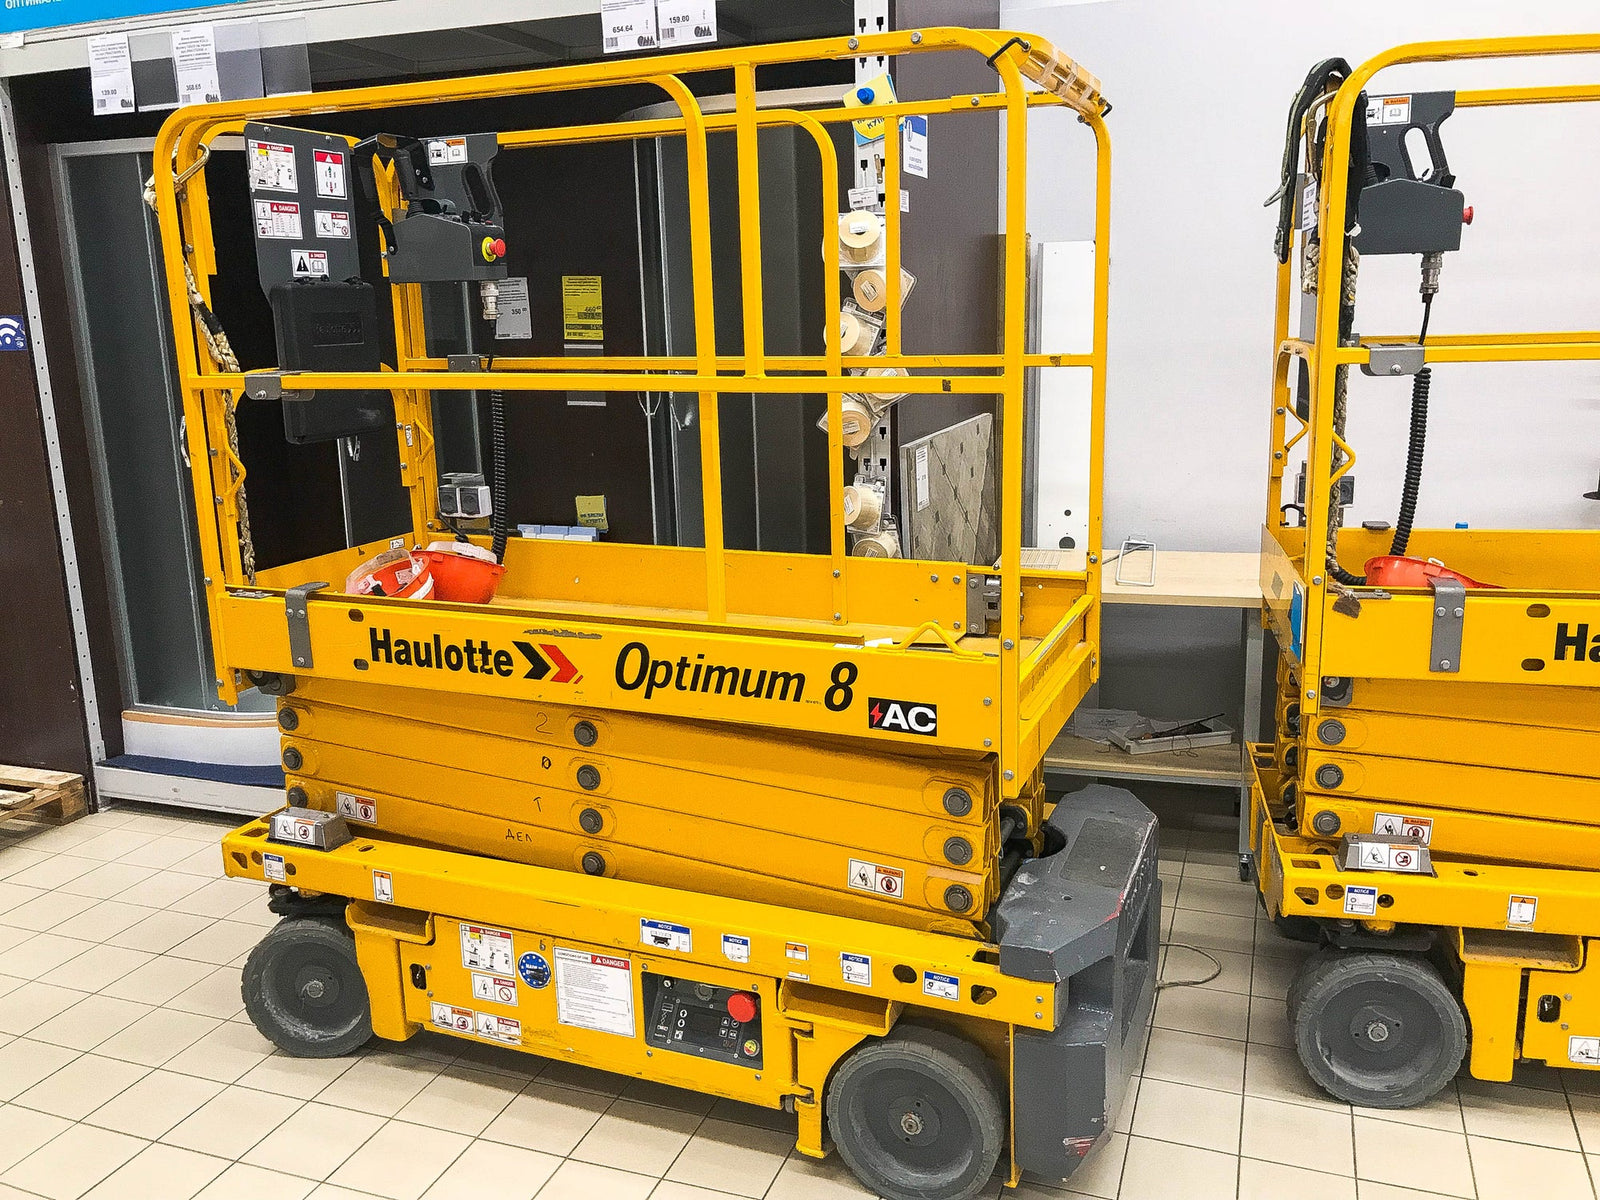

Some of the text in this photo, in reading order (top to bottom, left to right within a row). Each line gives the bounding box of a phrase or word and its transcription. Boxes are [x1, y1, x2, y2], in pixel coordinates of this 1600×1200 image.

[669, 15, 690, 23] 159.00
[612, 25, 633, 33] 654.64
[278, 204, 297, 212] DANGER
[369, 627, 514, 677] Haulotte
[615, 641, 858, 712] Optimum 8
[536, 711, 555, 735] 2
[881, 703, 937, 734] AC
[657, 923, 673, 931] NOTICE
[484, 929, 501, 937] DANGER
[728, 936, 743, 945] NOTICE
[602, 957, 626, 968] DANGER
[848, 955, 864, 963] NOTICE
[499, 979, 515, 987] DANGER
[933, 974, 950, 983] NOTICE
[503, 1018, 518, 1027] DANGER
